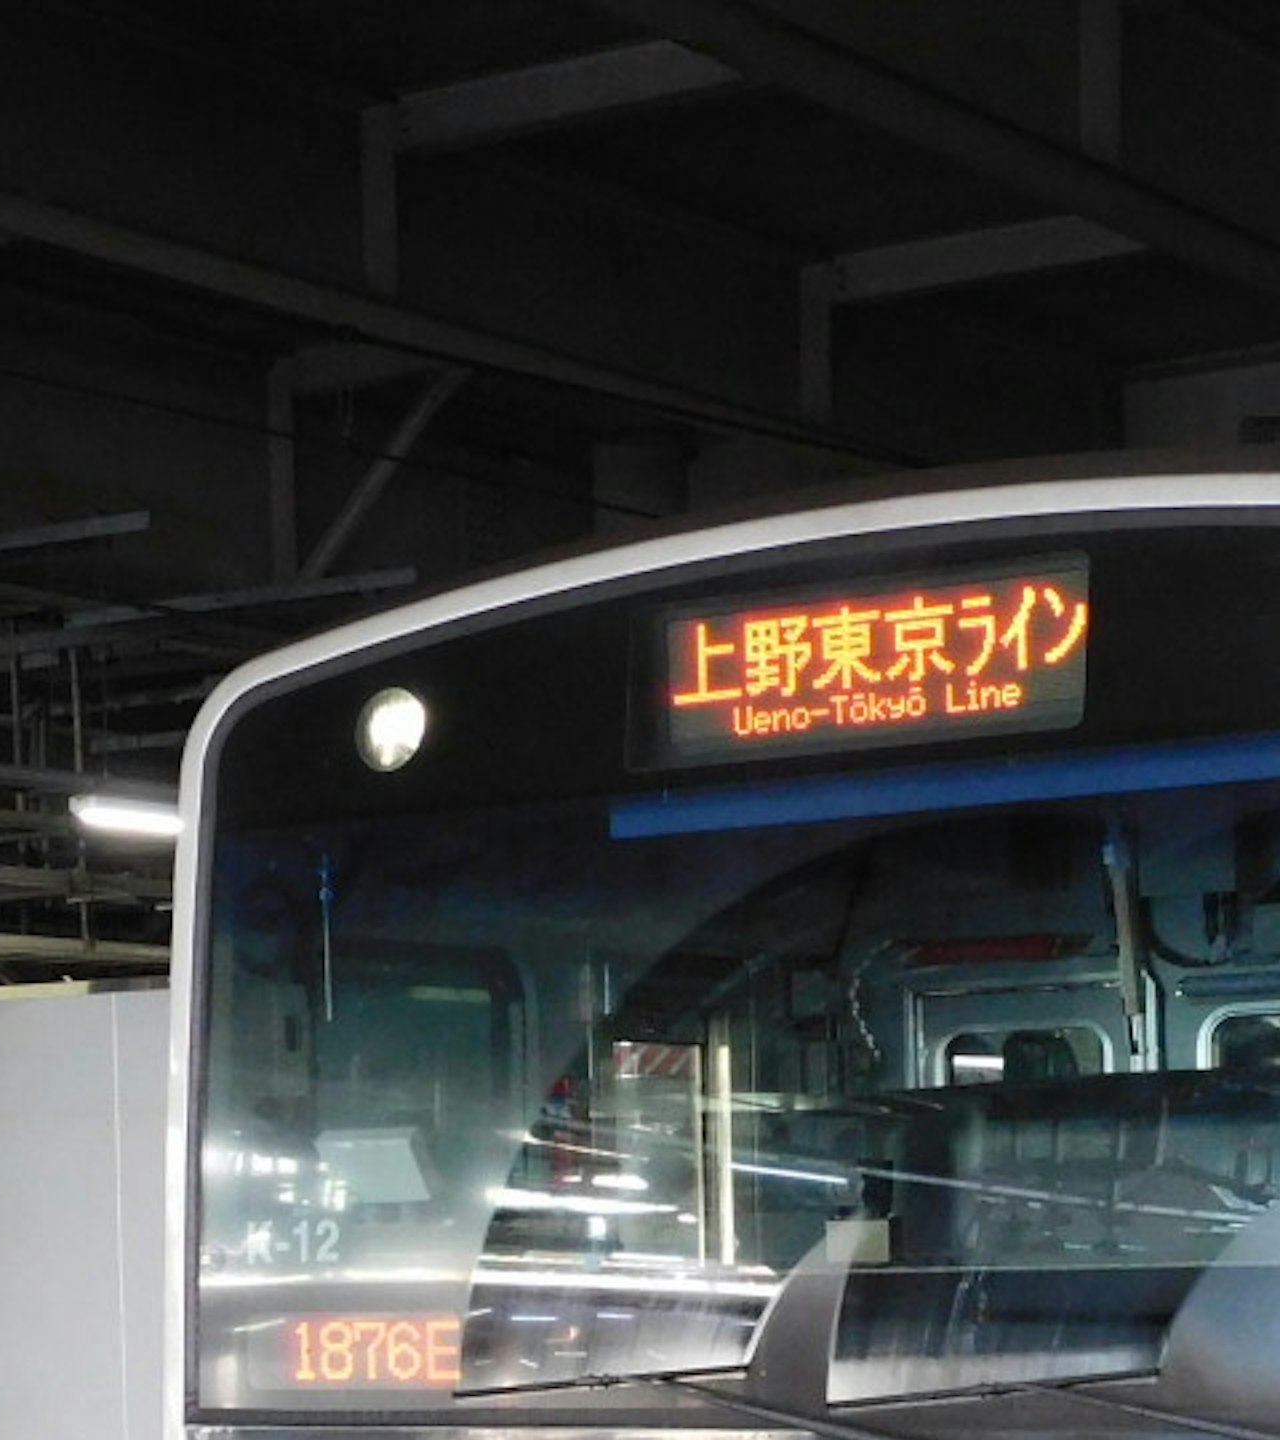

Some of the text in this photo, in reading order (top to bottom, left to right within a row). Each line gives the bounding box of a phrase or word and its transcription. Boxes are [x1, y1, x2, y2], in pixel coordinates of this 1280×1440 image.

[673, 584, 1087, 706] 上野東京ライン
[732, 680, 1022, 738] Ueno-Tōkyō Line
[245, 1219, 340, 1266] K-12
[294, 1319, 462, 1383] 1876E
